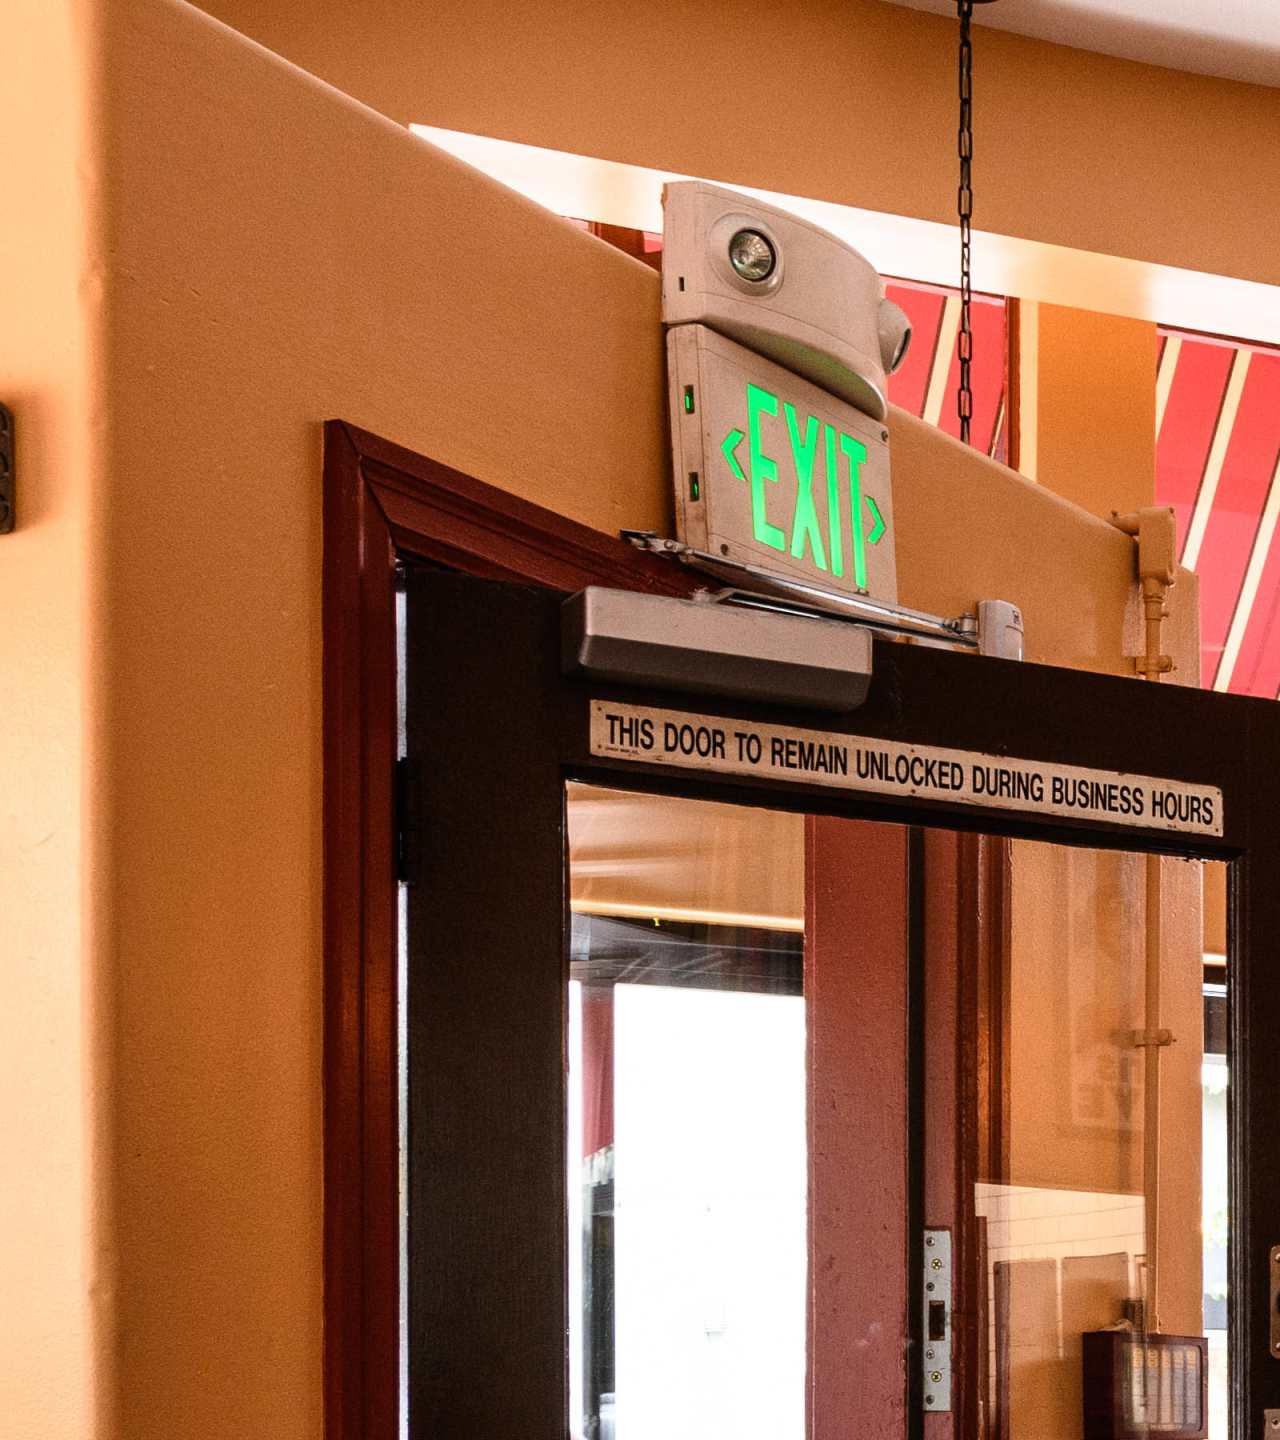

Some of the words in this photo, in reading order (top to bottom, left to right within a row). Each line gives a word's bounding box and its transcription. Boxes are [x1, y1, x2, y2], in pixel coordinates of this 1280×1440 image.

[747, 383, 867, 590] EXIT
[606, 714, 654, 750] THIS
[664, 723, 725, 759] DOOR
[734, 732, 761, 764] TO
[771, 737, 847, 775] REMAIN
[856, 749, 964, 791] UNLOCKED
[973, 765, 1044, 802] DURING
[1052, 777, 1144, 816] BUSINESS
[1152, 790, 1213, 825] HOURS
